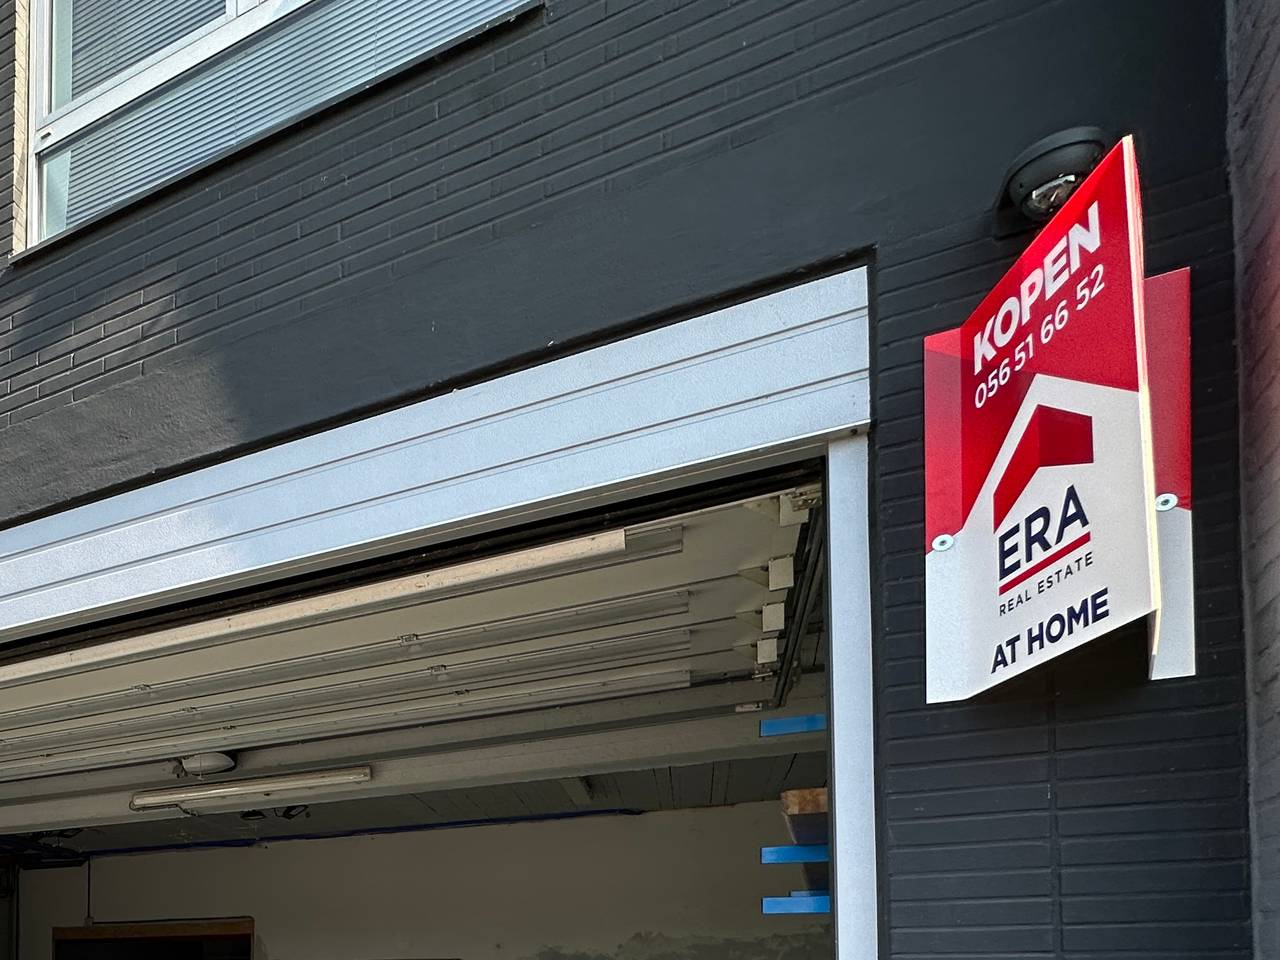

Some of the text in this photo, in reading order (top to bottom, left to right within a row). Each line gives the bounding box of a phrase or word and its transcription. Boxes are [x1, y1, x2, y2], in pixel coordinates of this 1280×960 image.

[973, 200, 1101, 376] KOPEN
[974, 263, 1105, 409] 056 51 66 52
[998, 484, 1090, 581] ERA
[990, 587, 1110, 675] AT HOME
[999, 551, 1094, 617] REAL ESTATE
